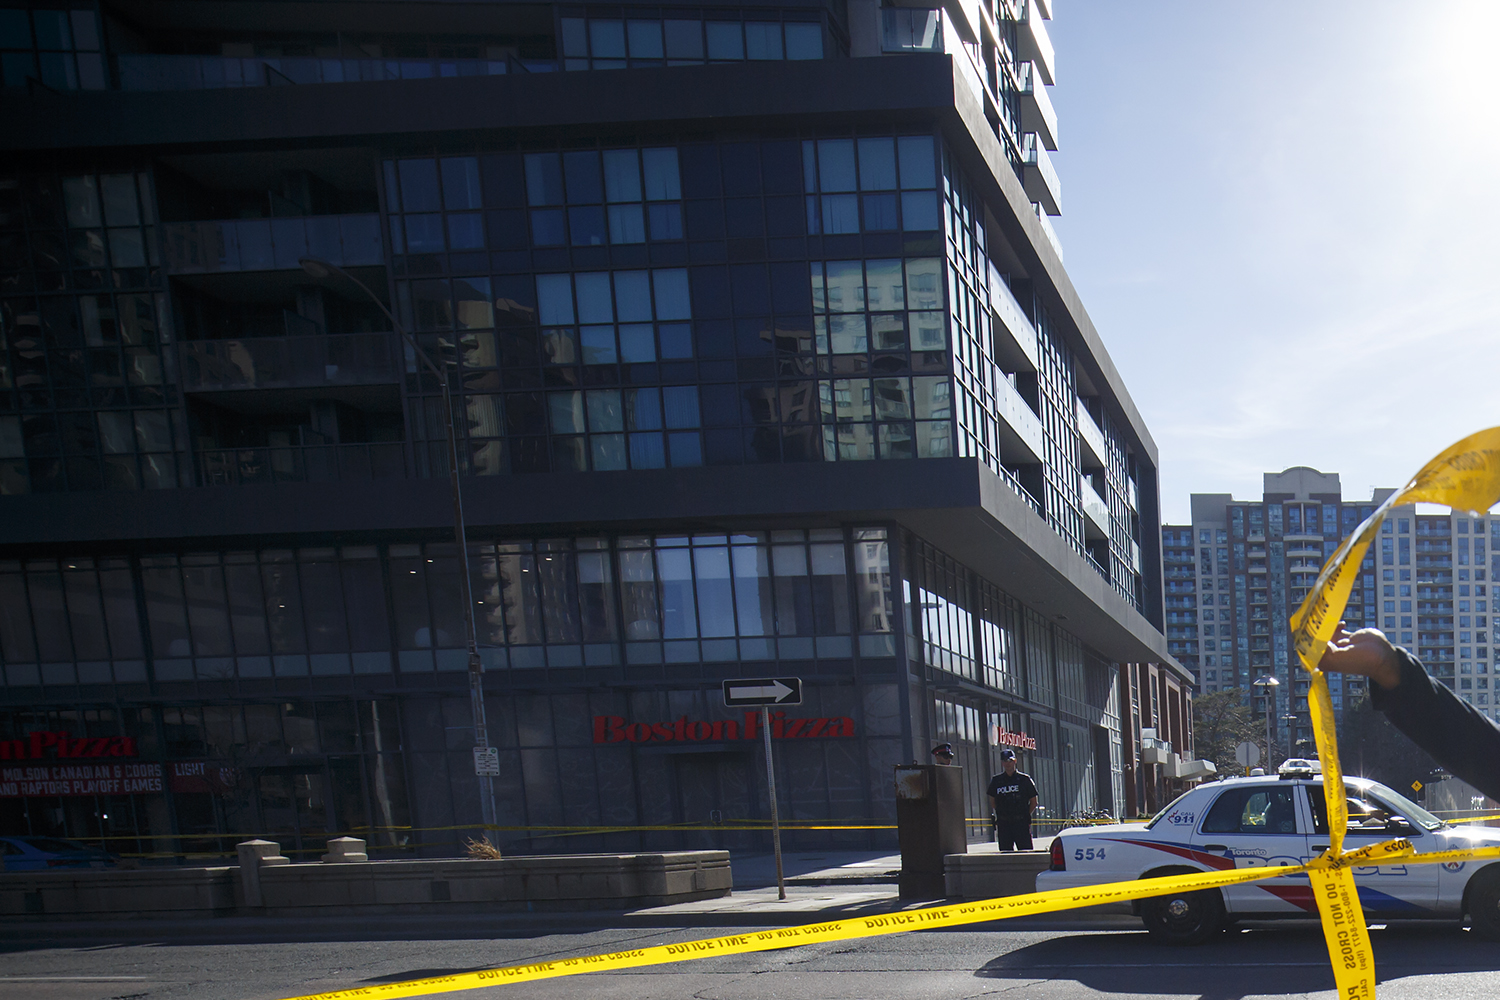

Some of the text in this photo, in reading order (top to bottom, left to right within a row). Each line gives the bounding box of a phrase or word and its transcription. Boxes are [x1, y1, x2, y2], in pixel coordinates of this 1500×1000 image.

[593, 710, 856, 744] Boston Pizza
[29, 730, 139, 759] Pizza
[2, 762, 206, 782] MOLSON CANADIAN & COORS LIGHT
[21, 780, 71, 796] RAPTORS
[73, 778, 121, 794] PLAYOFF
[123, 777, 163, 793] GAMES
[997, 785, 1020, 795] POLICE
[1074, 848, 1106, 861] 554
[1229, 847, 1267, 857] Toronto
[1232, 855, 1408, 876] POCE
